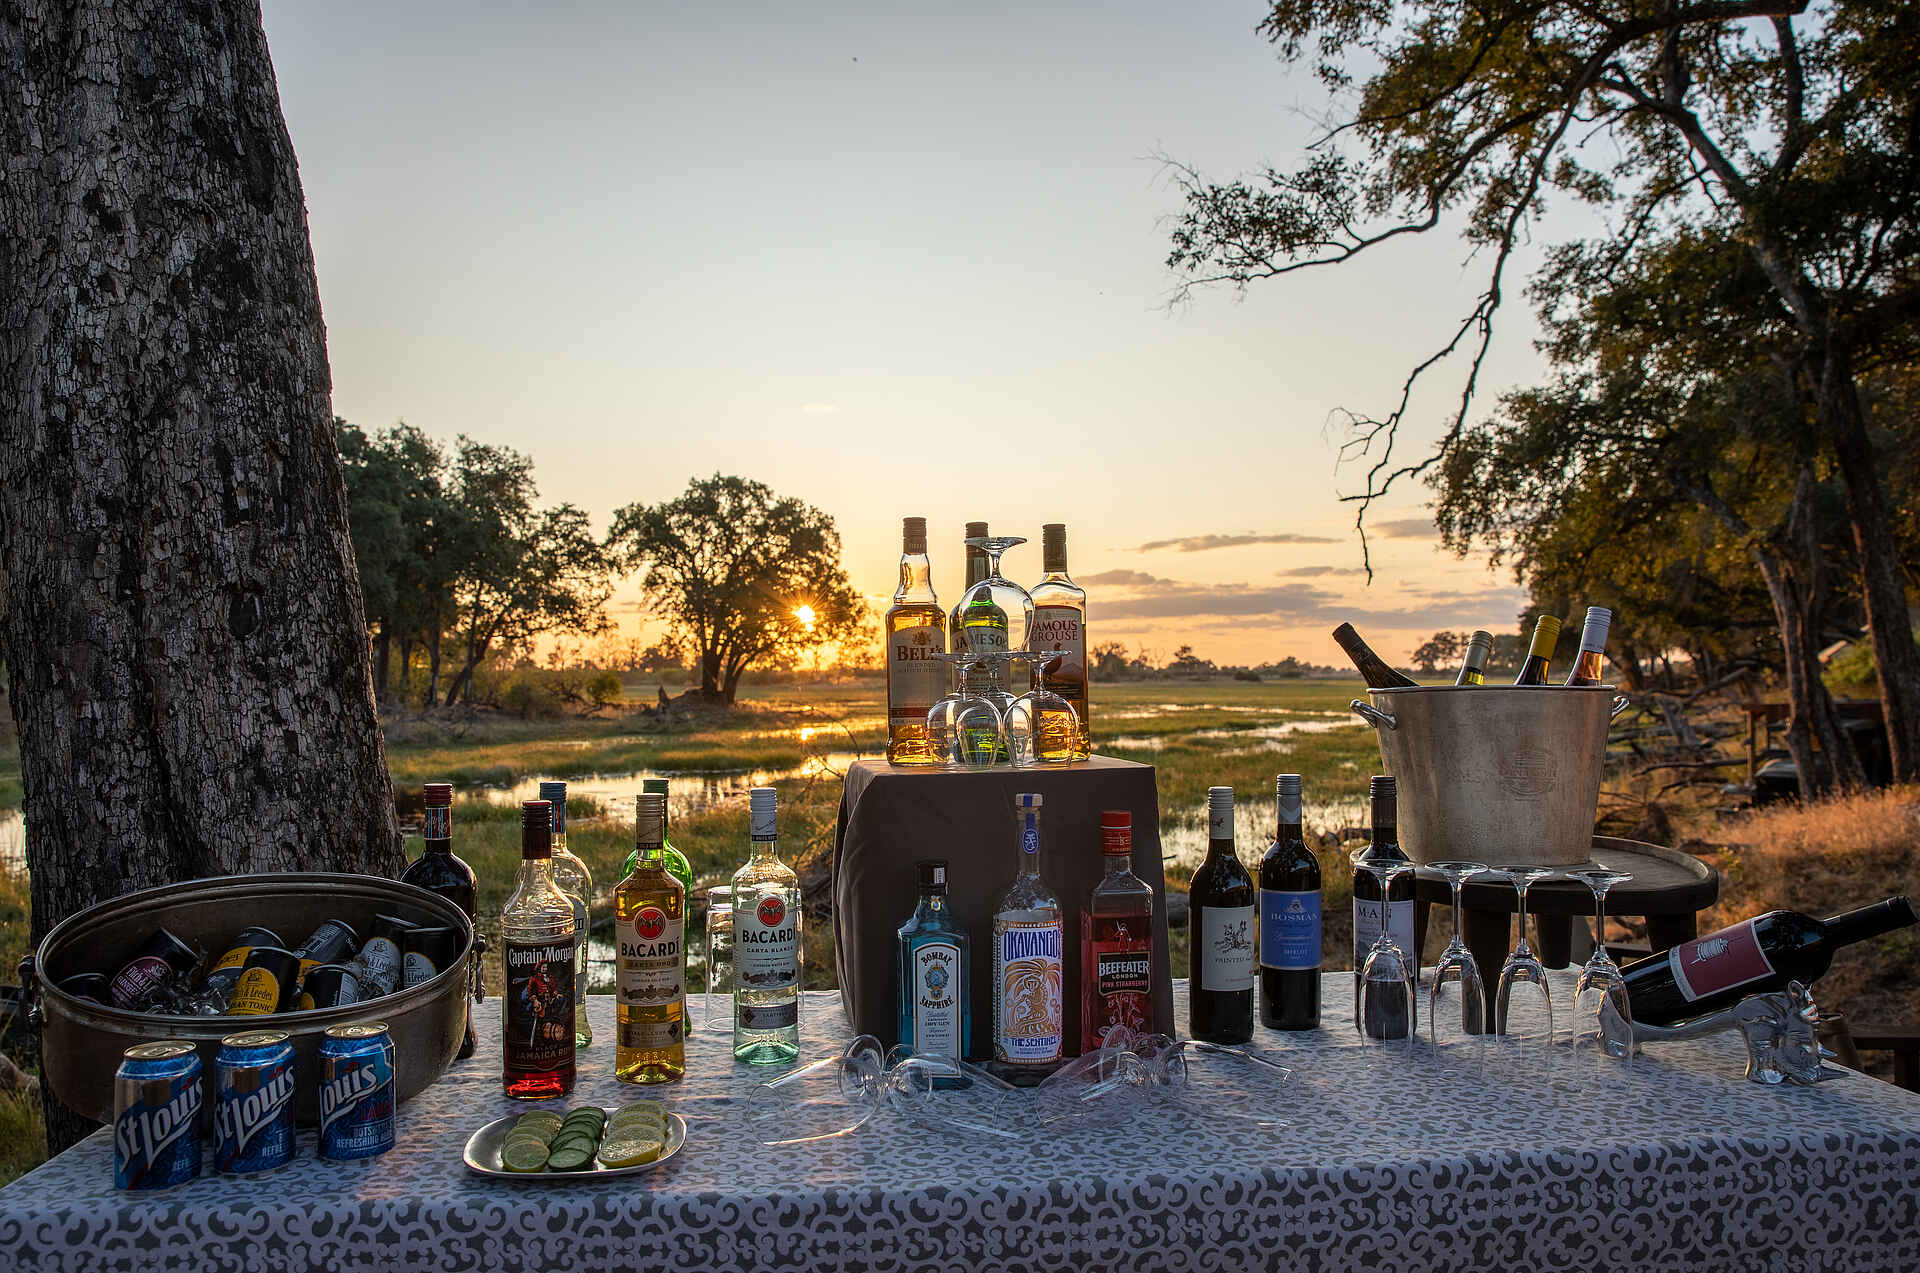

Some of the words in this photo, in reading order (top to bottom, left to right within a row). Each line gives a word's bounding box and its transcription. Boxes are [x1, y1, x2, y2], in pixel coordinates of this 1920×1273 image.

[1003, 929, 1058, 961] OKAVANGO
[508, 947, 544, 968] Captain
[921, 951, 953, 967] BOMBAY
[1098, 960, 1150, 977] BEEFEATER
[920, 995, 954, 1010] SAPPHIRE
